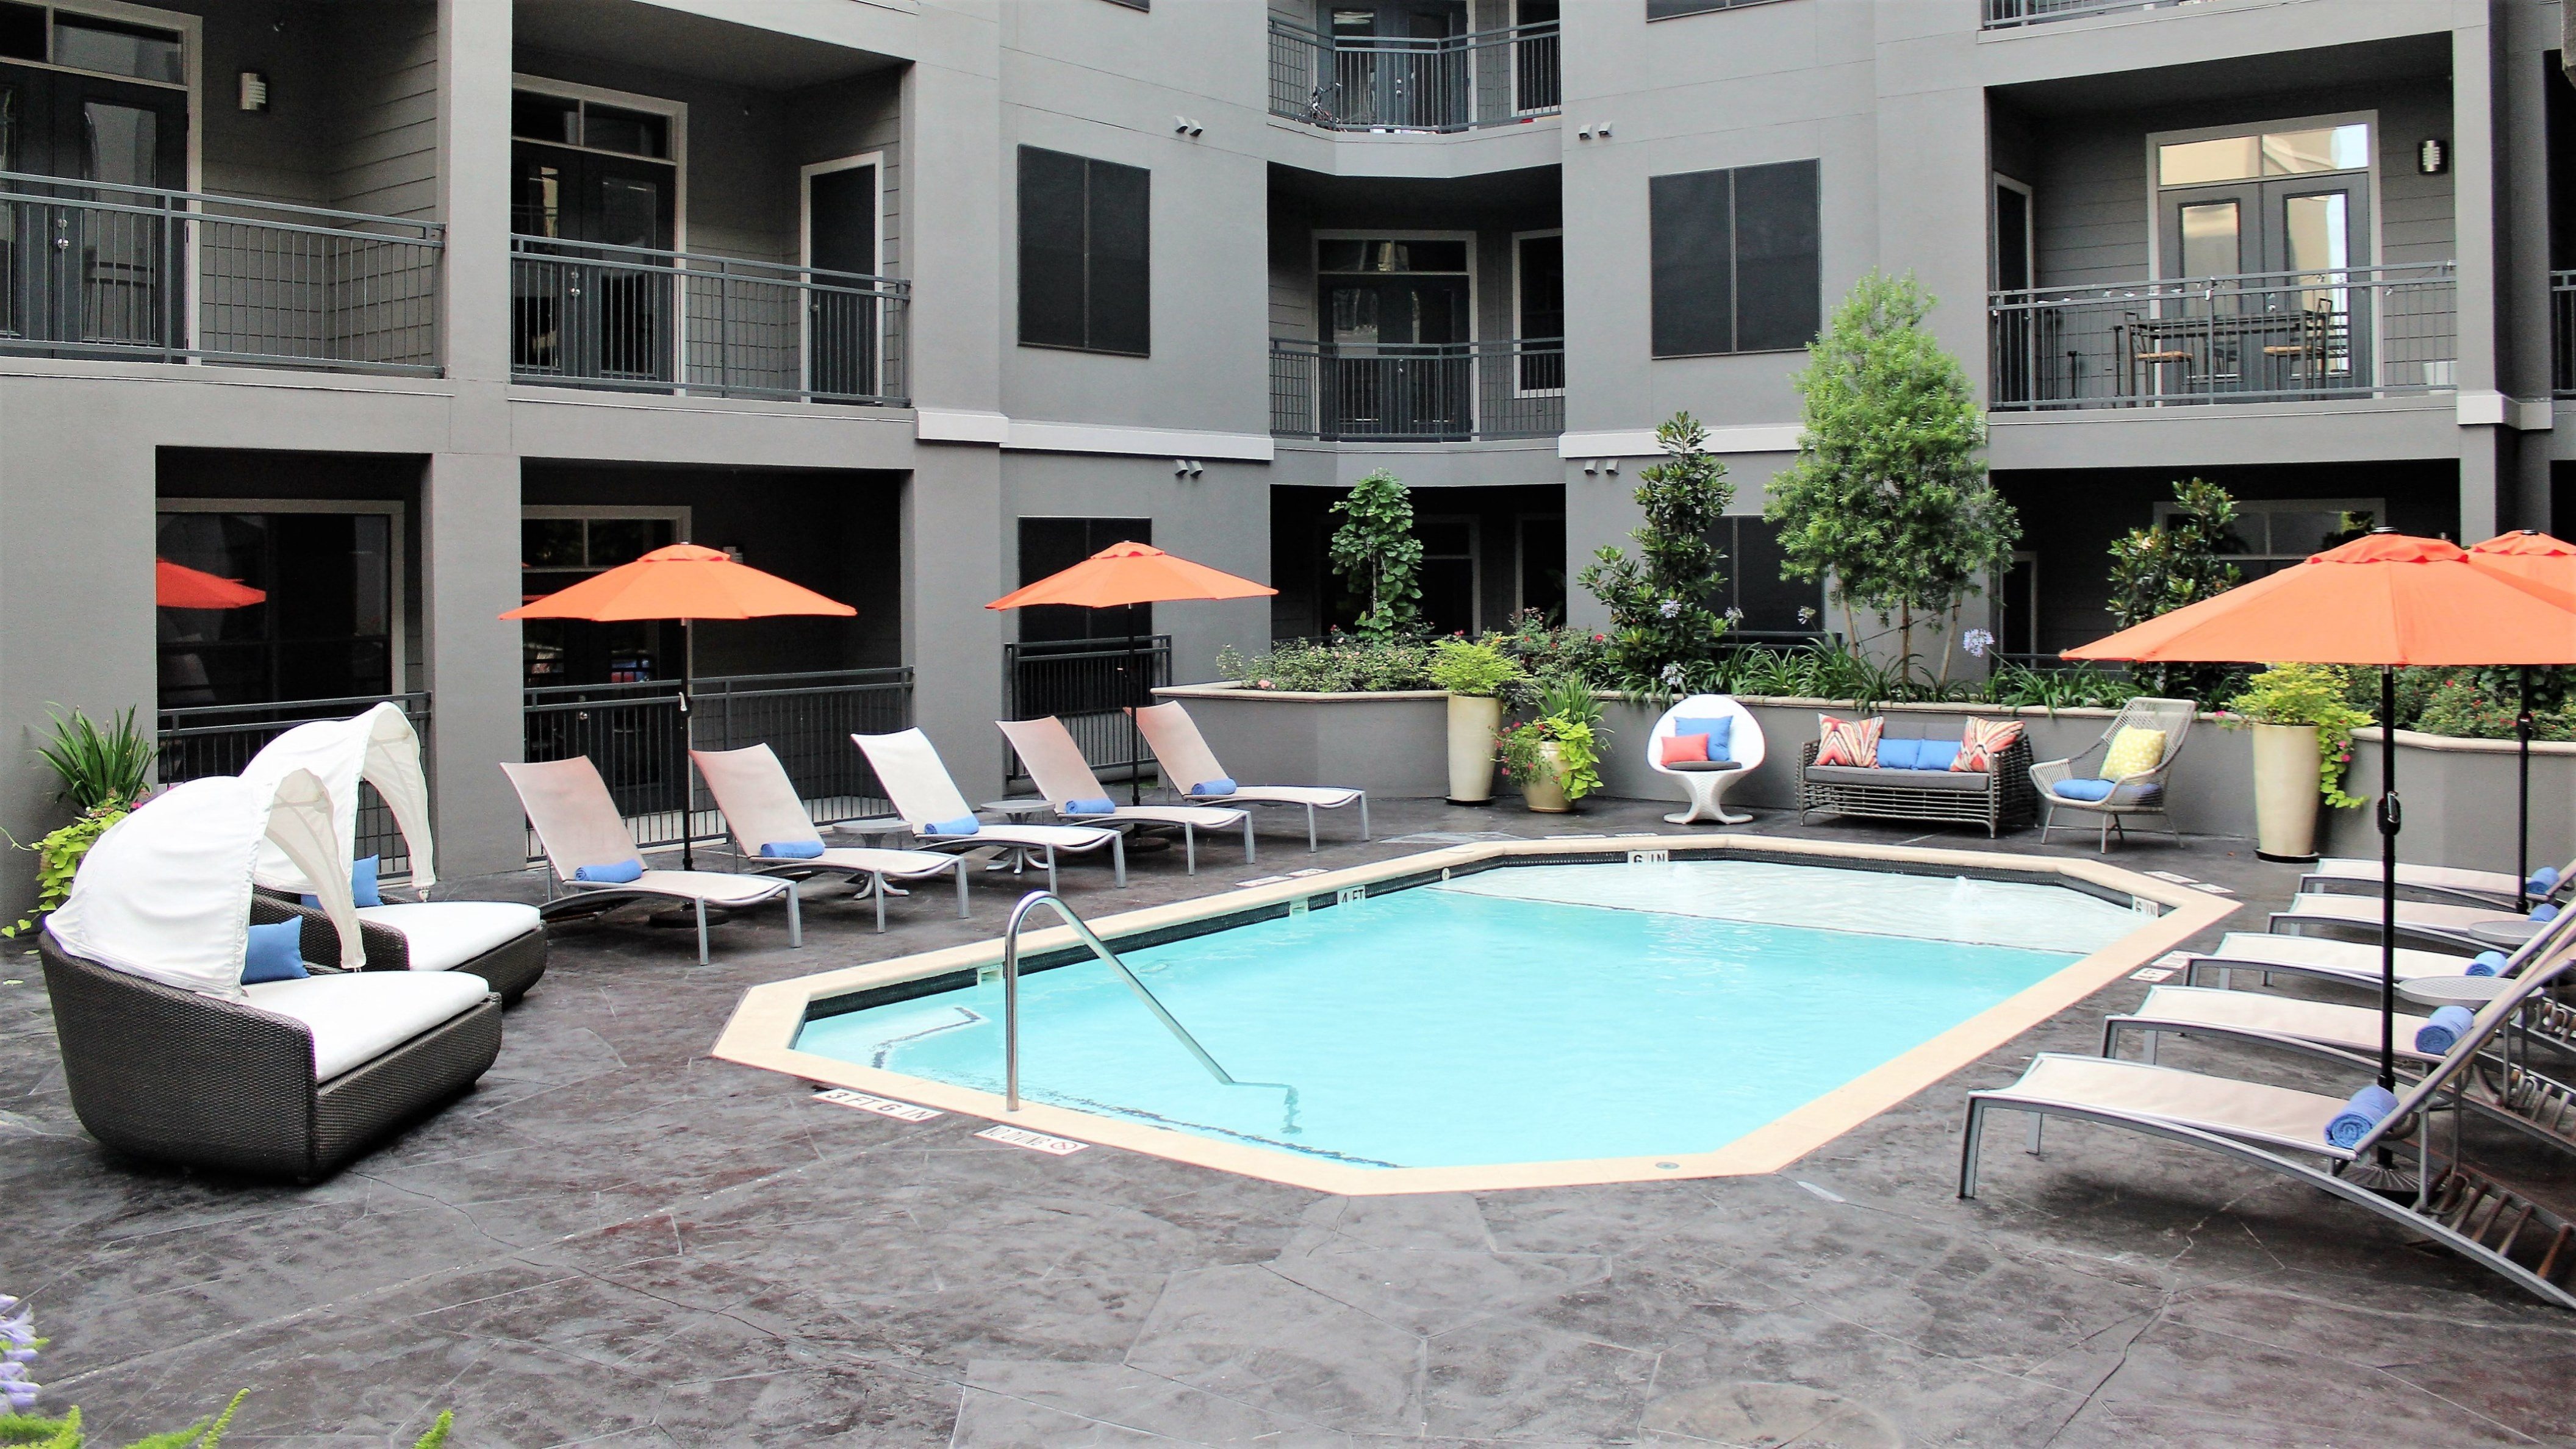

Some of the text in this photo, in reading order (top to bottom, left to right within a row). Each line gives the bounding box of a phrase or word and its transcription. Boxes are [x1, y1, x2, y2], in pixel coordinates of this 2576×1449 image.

[1651, 854, 1665, 863] IN
[1352, 889, 1364, 901] FT
[845, 1097, 882, 1106] FT
[900, 1109, 934, 1118] IN
[983, 1127, 1051, 1146] NO DIVING
